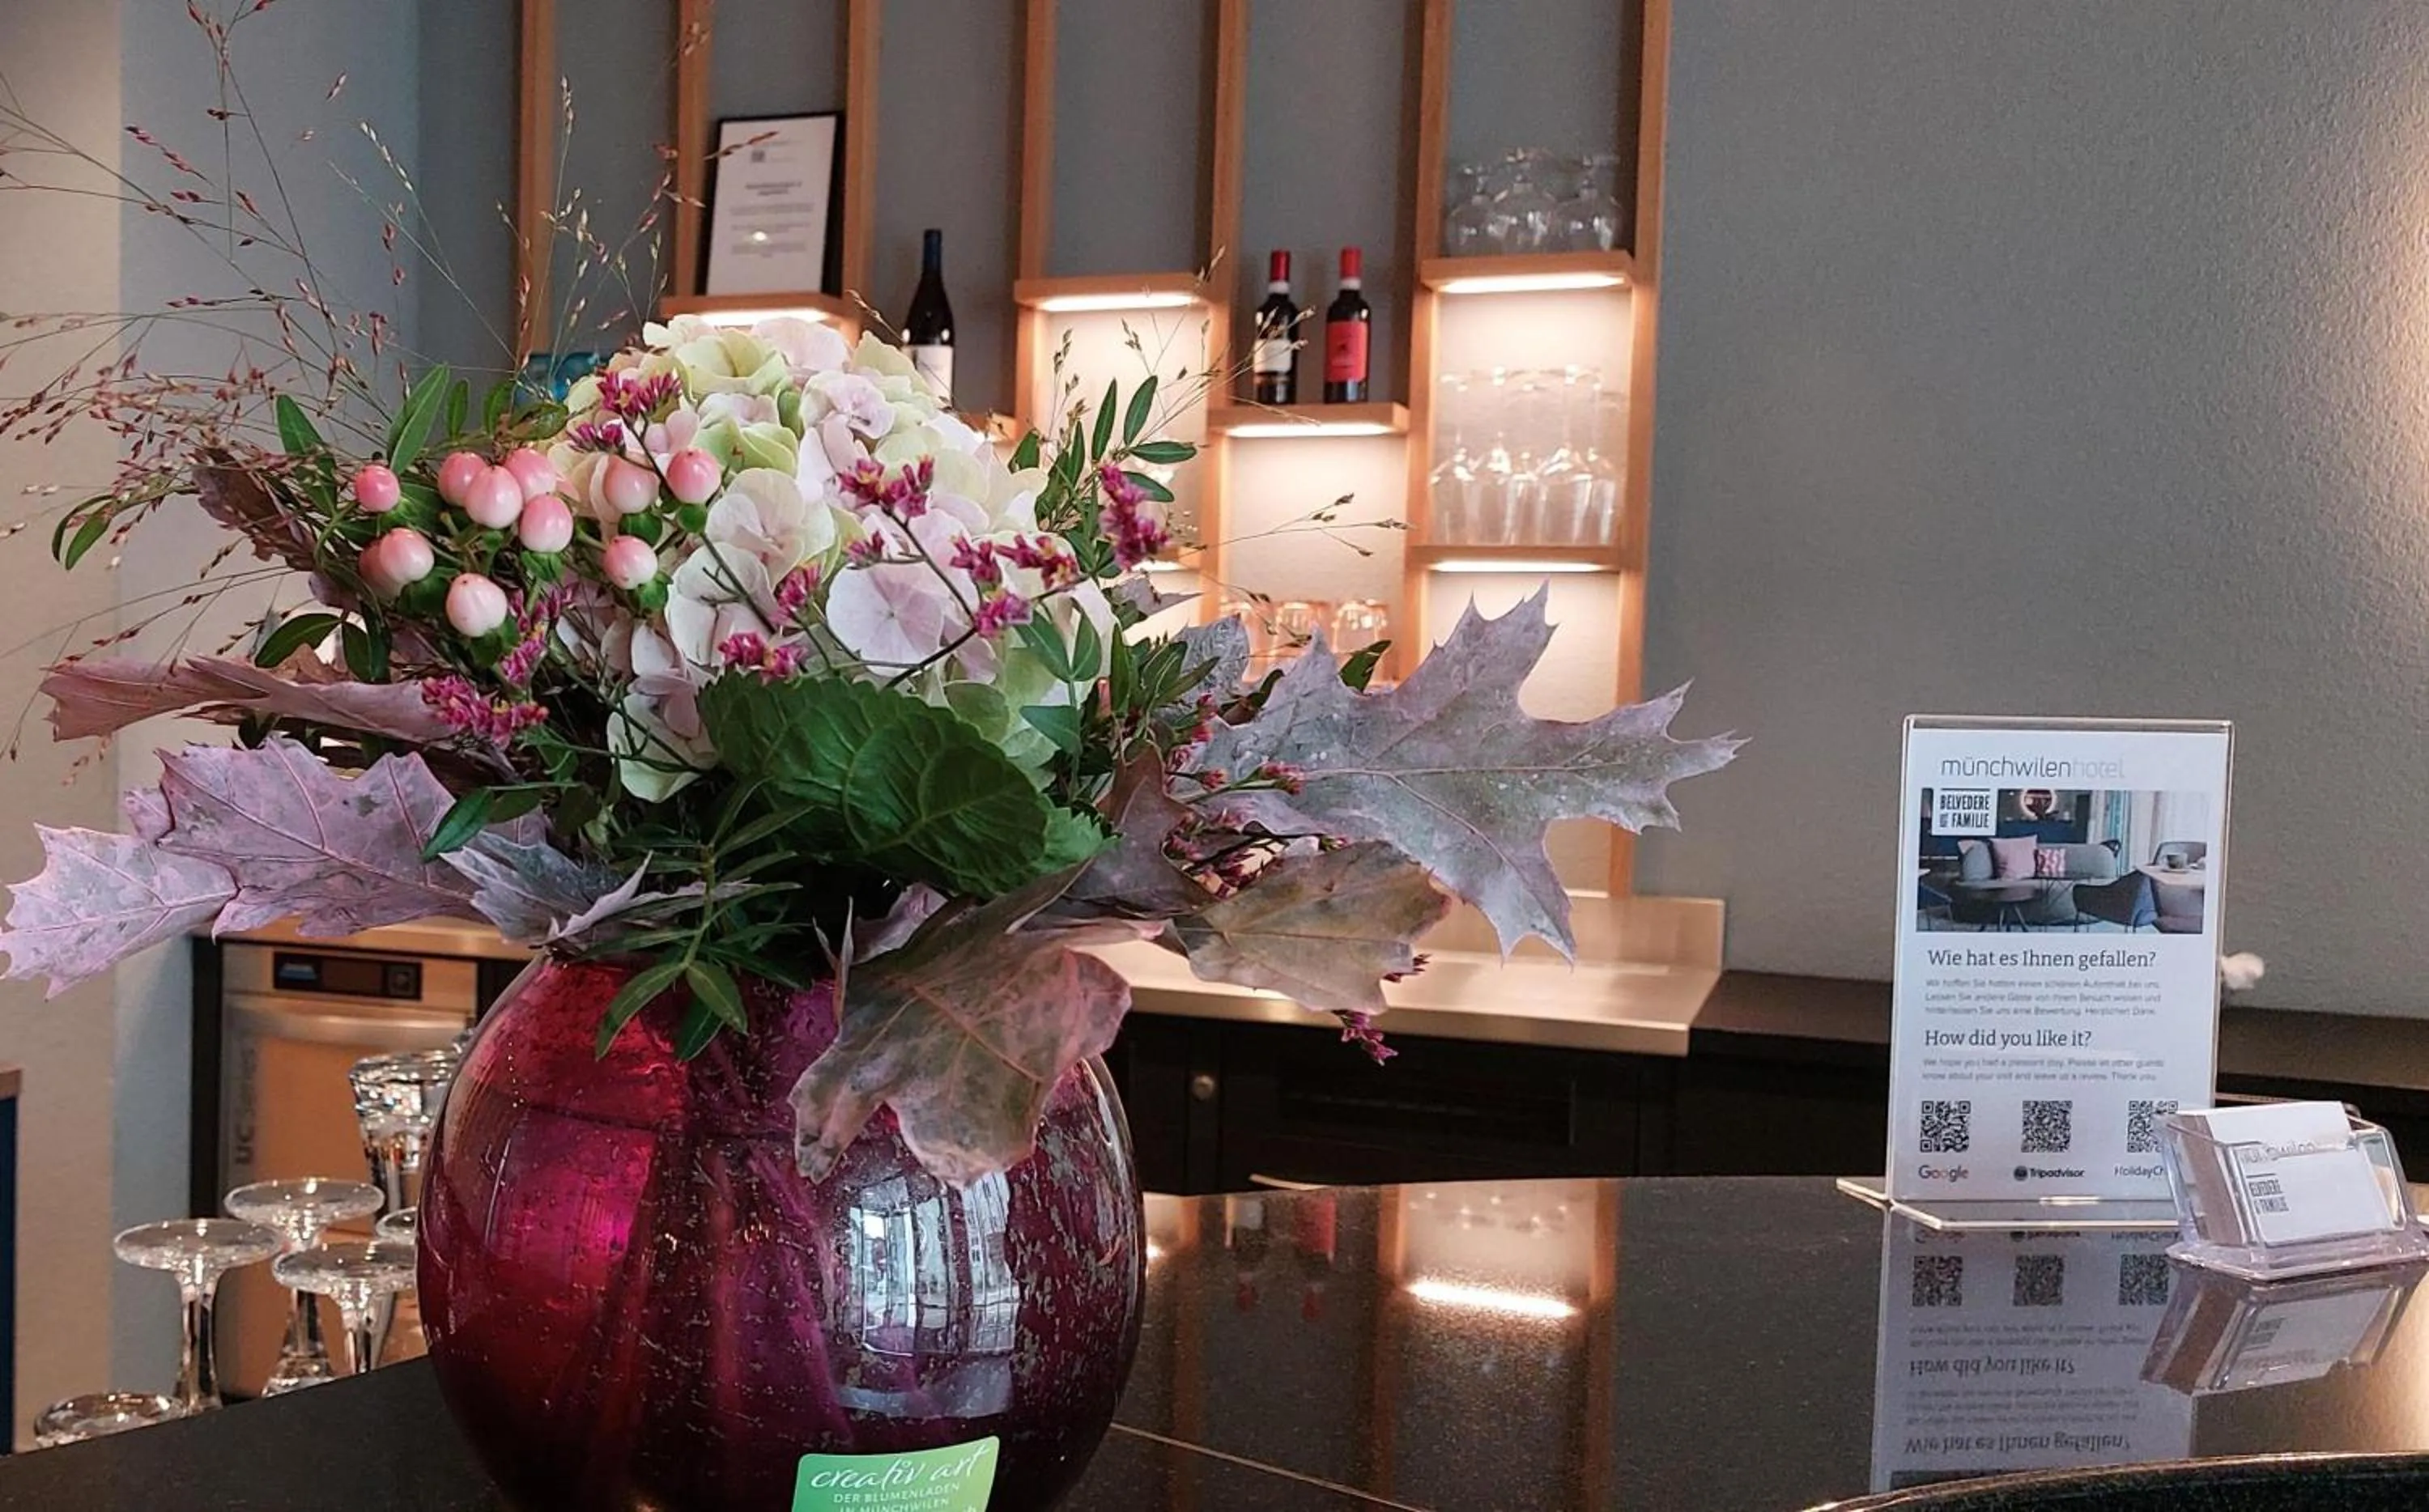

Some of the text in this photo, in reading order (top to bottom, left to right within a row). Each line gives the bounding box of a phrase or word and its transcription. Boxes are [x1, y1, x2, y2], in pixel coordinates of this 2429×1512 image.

[1940, 794, 1990, 810] BELVEDERE
[1928, 949, 2156, 971] Wie hat es Ihnen gefallen?
[1925, 1030, 2092, 1050] How did you like it?
[1918, 1165, 1969, 1182] Google
[2029, 1166, 2085, 1179] Tripadvisor
[2114, 1165, 2164, 1179] HolidayCh
[810, 1444, 990, 1492] creativ art
[833, 1482, 960, 1504] DER BLUMENLADEN
